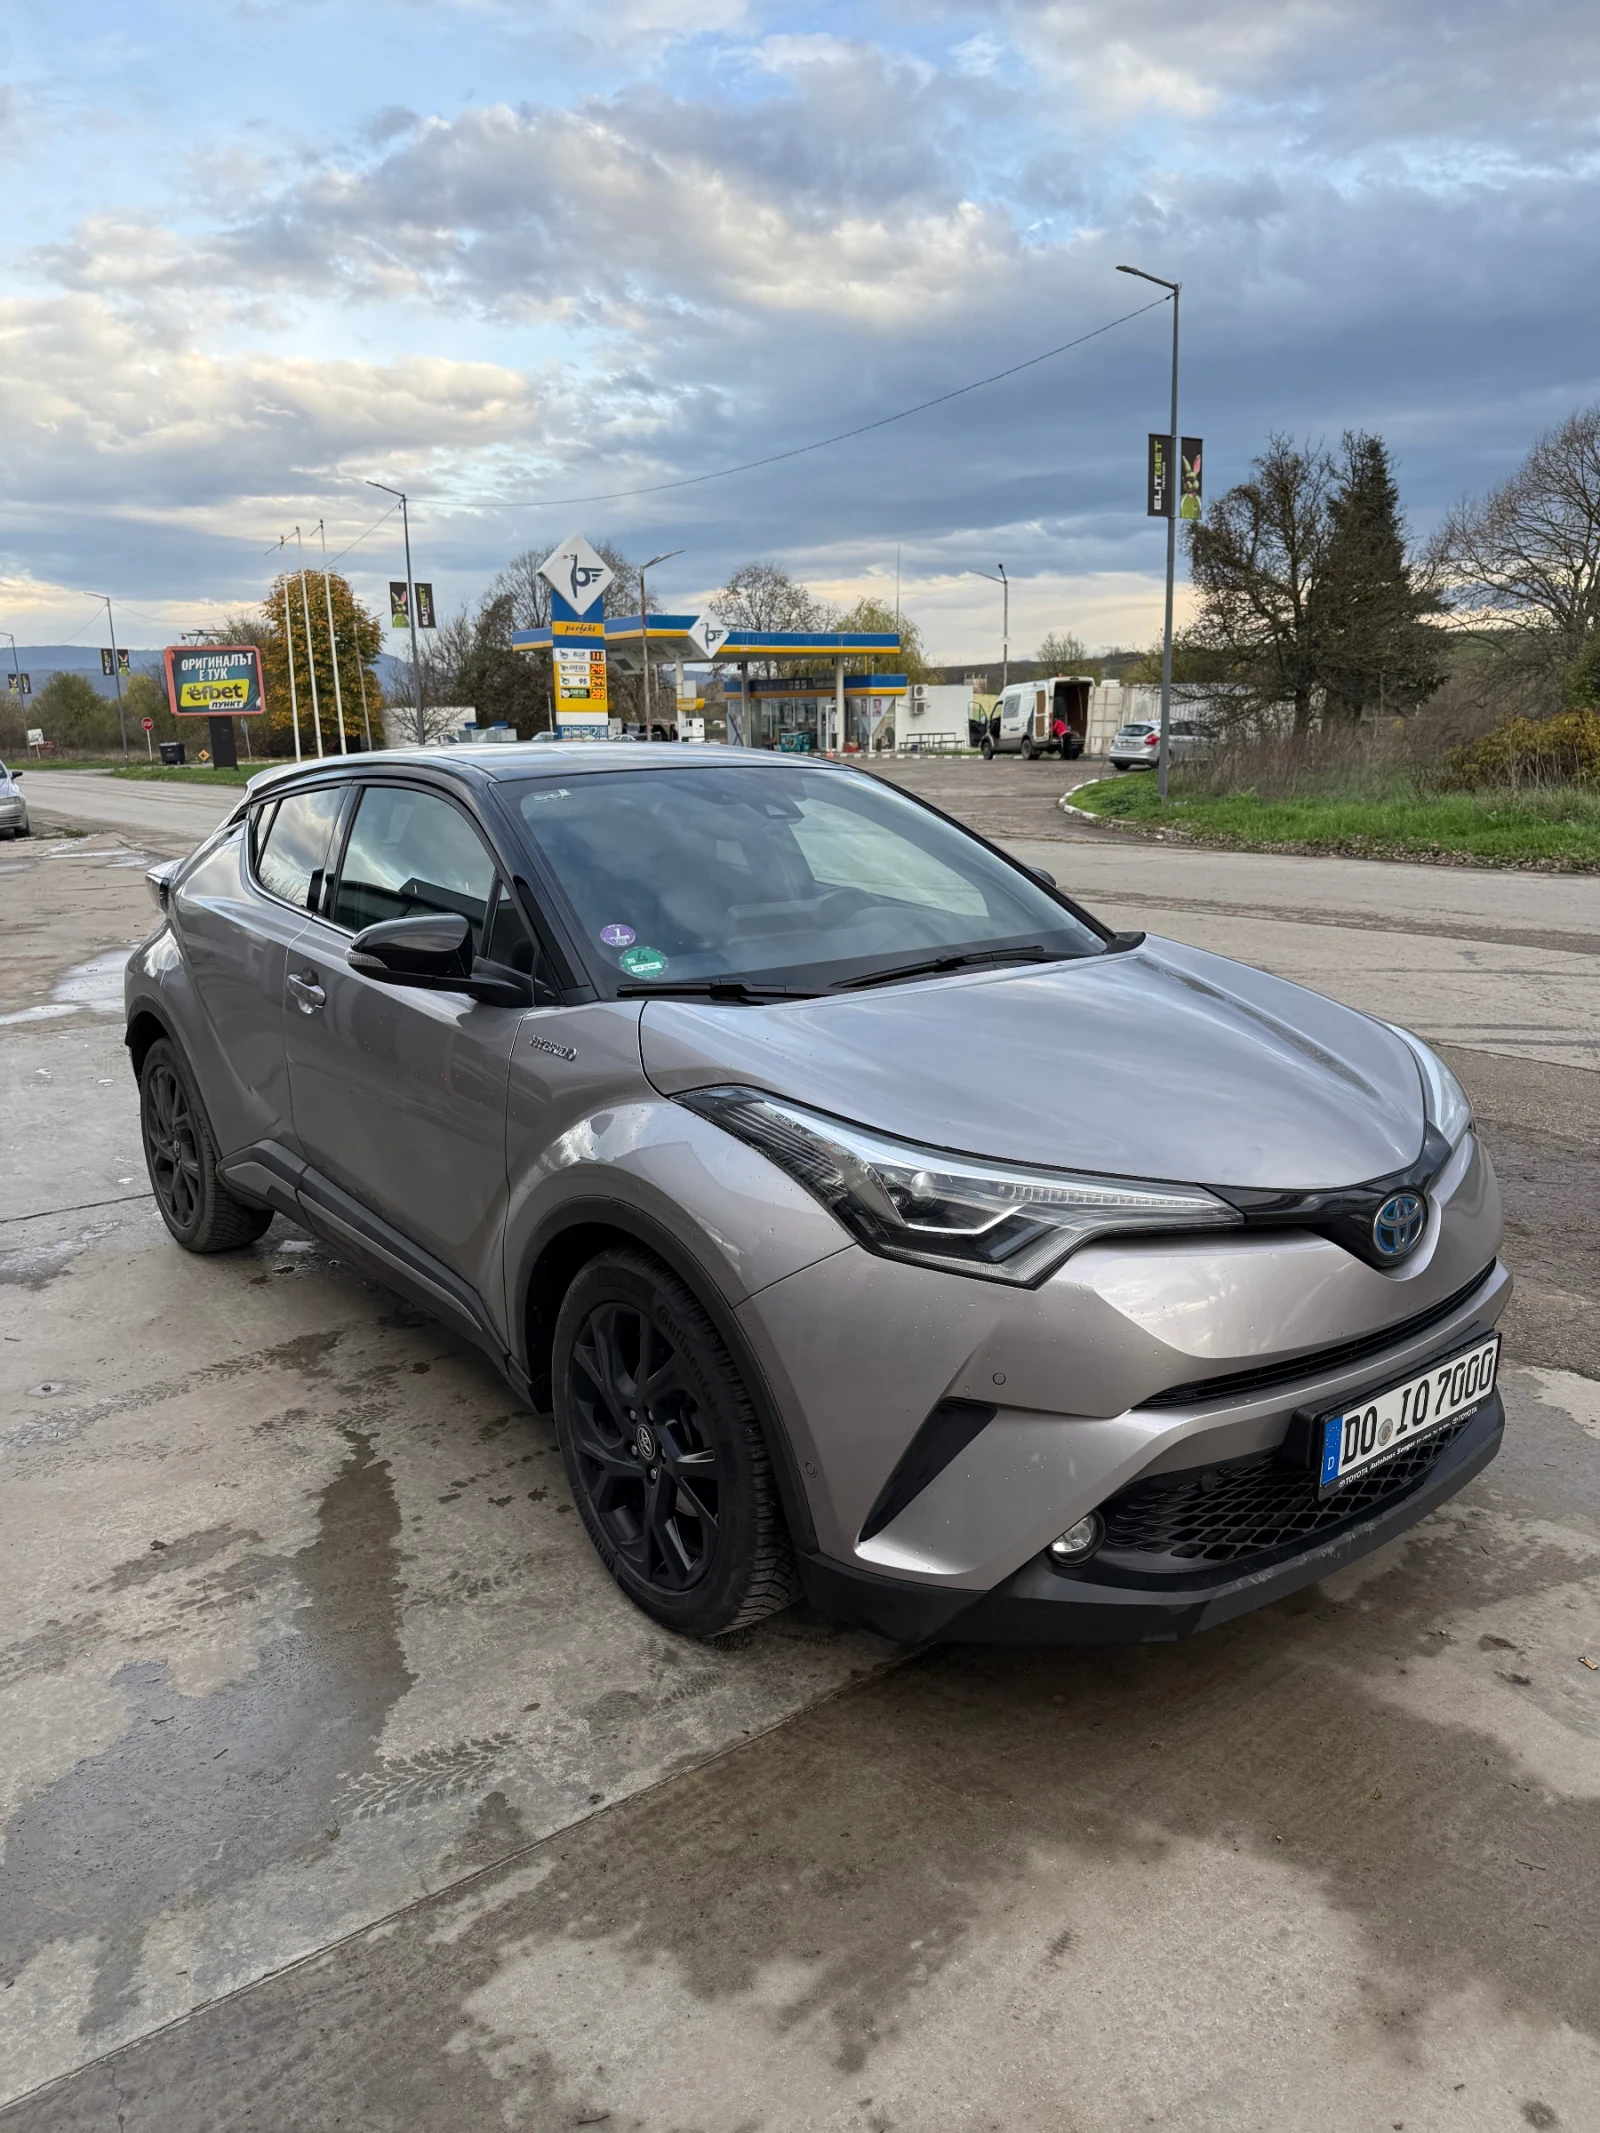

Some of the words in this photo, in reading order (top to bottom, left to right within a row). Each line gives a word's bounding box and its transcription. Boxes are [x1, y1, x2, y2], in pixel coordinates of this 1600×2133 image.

[565, 624, 596, 634] perfekt
[181, 652, 253, 671] ОРИГИНАЛЪТ
[199, 670, 205, 681] Е
[207, 668, 228, 681] ТУК
[187, 683, 243, 701] efbet
[211, 700, 242, 709] ПУНКТ
[637, 951, 649, 962] 4
[1341, 1405, 1378, 1467] DO
[1396, 1379, 1430, 1436] IO
[1434, 1347, 1494, 1416] 7000
[1458, 1406, 1478, 1420] TOYOTA
[1327, 1456, 1335, 1471] D
[1345, 1467, 1369, 1485] TOYOTA
[1369, 1452, 1396, 1470] Autohaus
